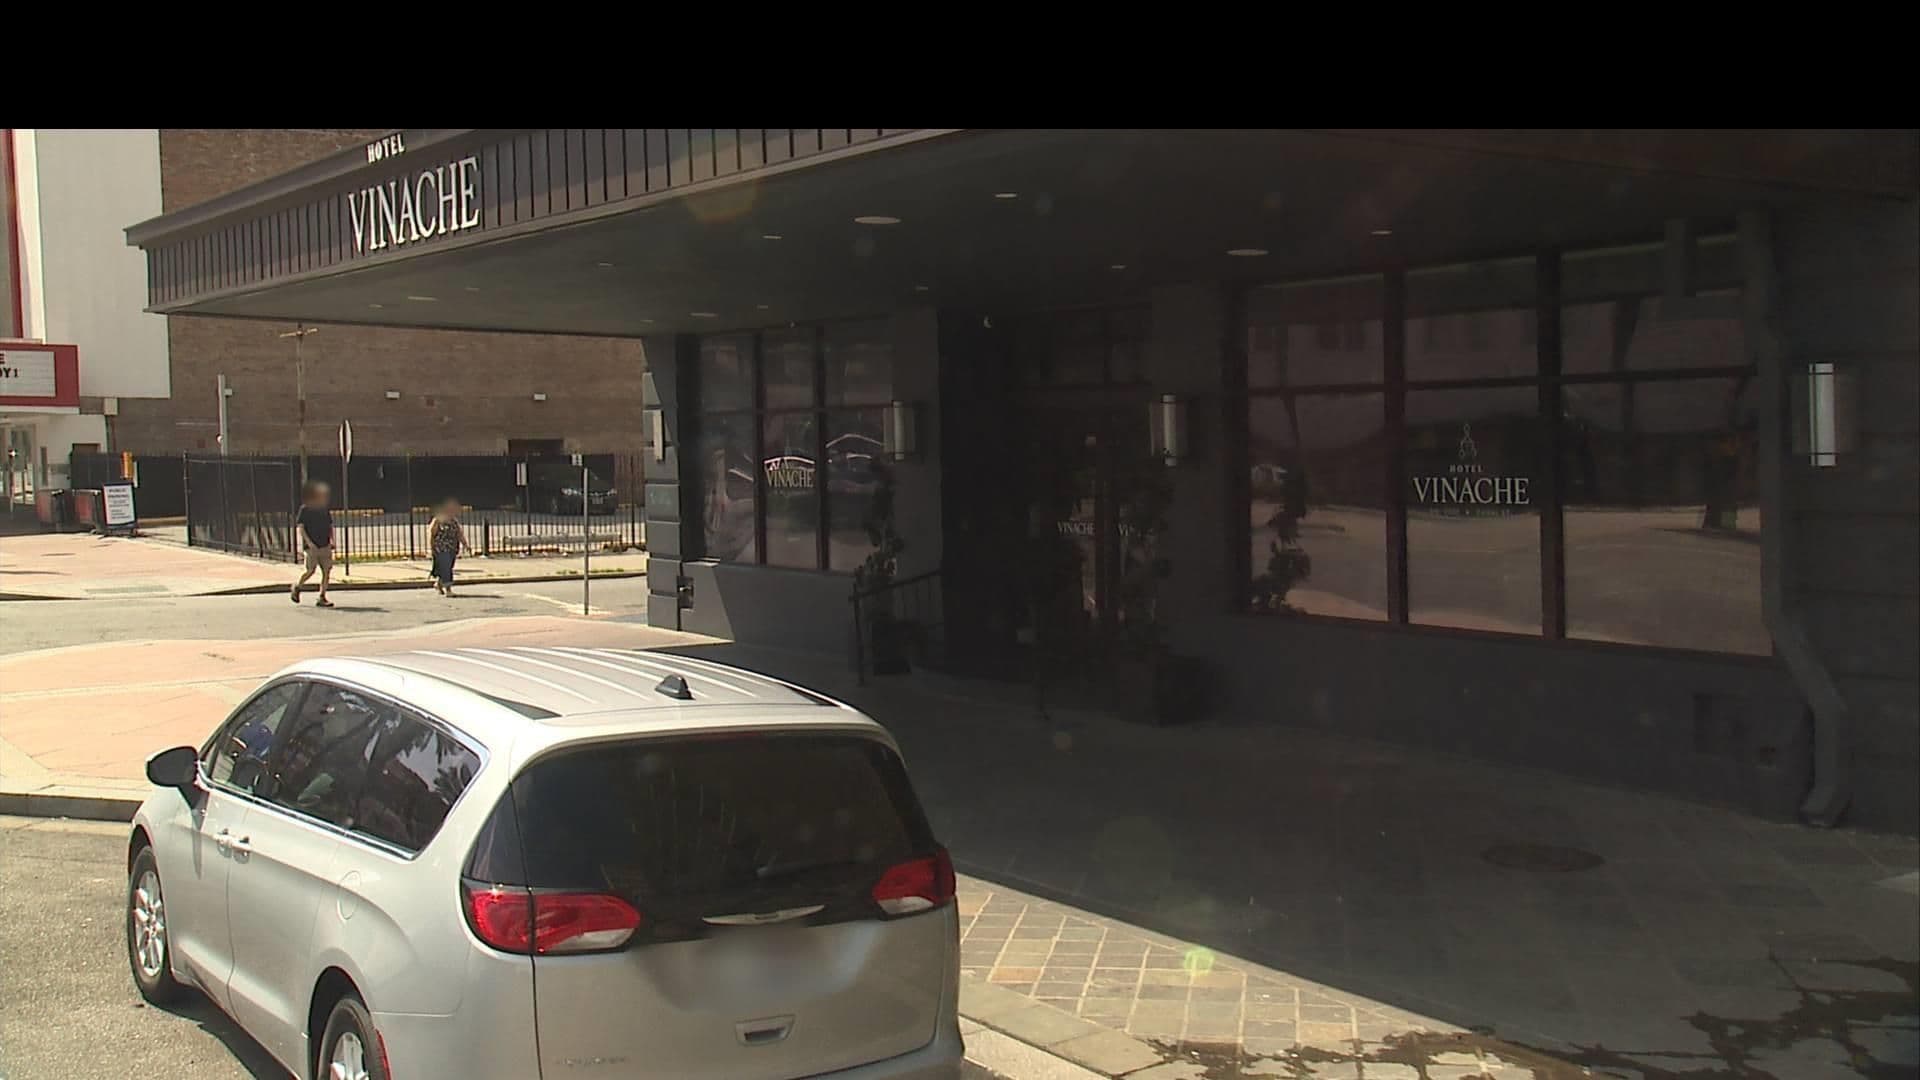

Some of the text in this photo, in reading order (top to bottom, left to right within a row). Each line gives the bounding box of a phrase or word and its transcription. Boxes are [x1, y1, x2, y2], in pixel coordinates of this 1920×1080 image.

[367, 133, 405, 163] HOTEL
[348, 157, 481, 253] VINACHE
[765, 469, 815, 488] VINACHE
[1449, 464, 1483, 473] HOTEL
[1413, 477, 1530, 505] VINACHE
